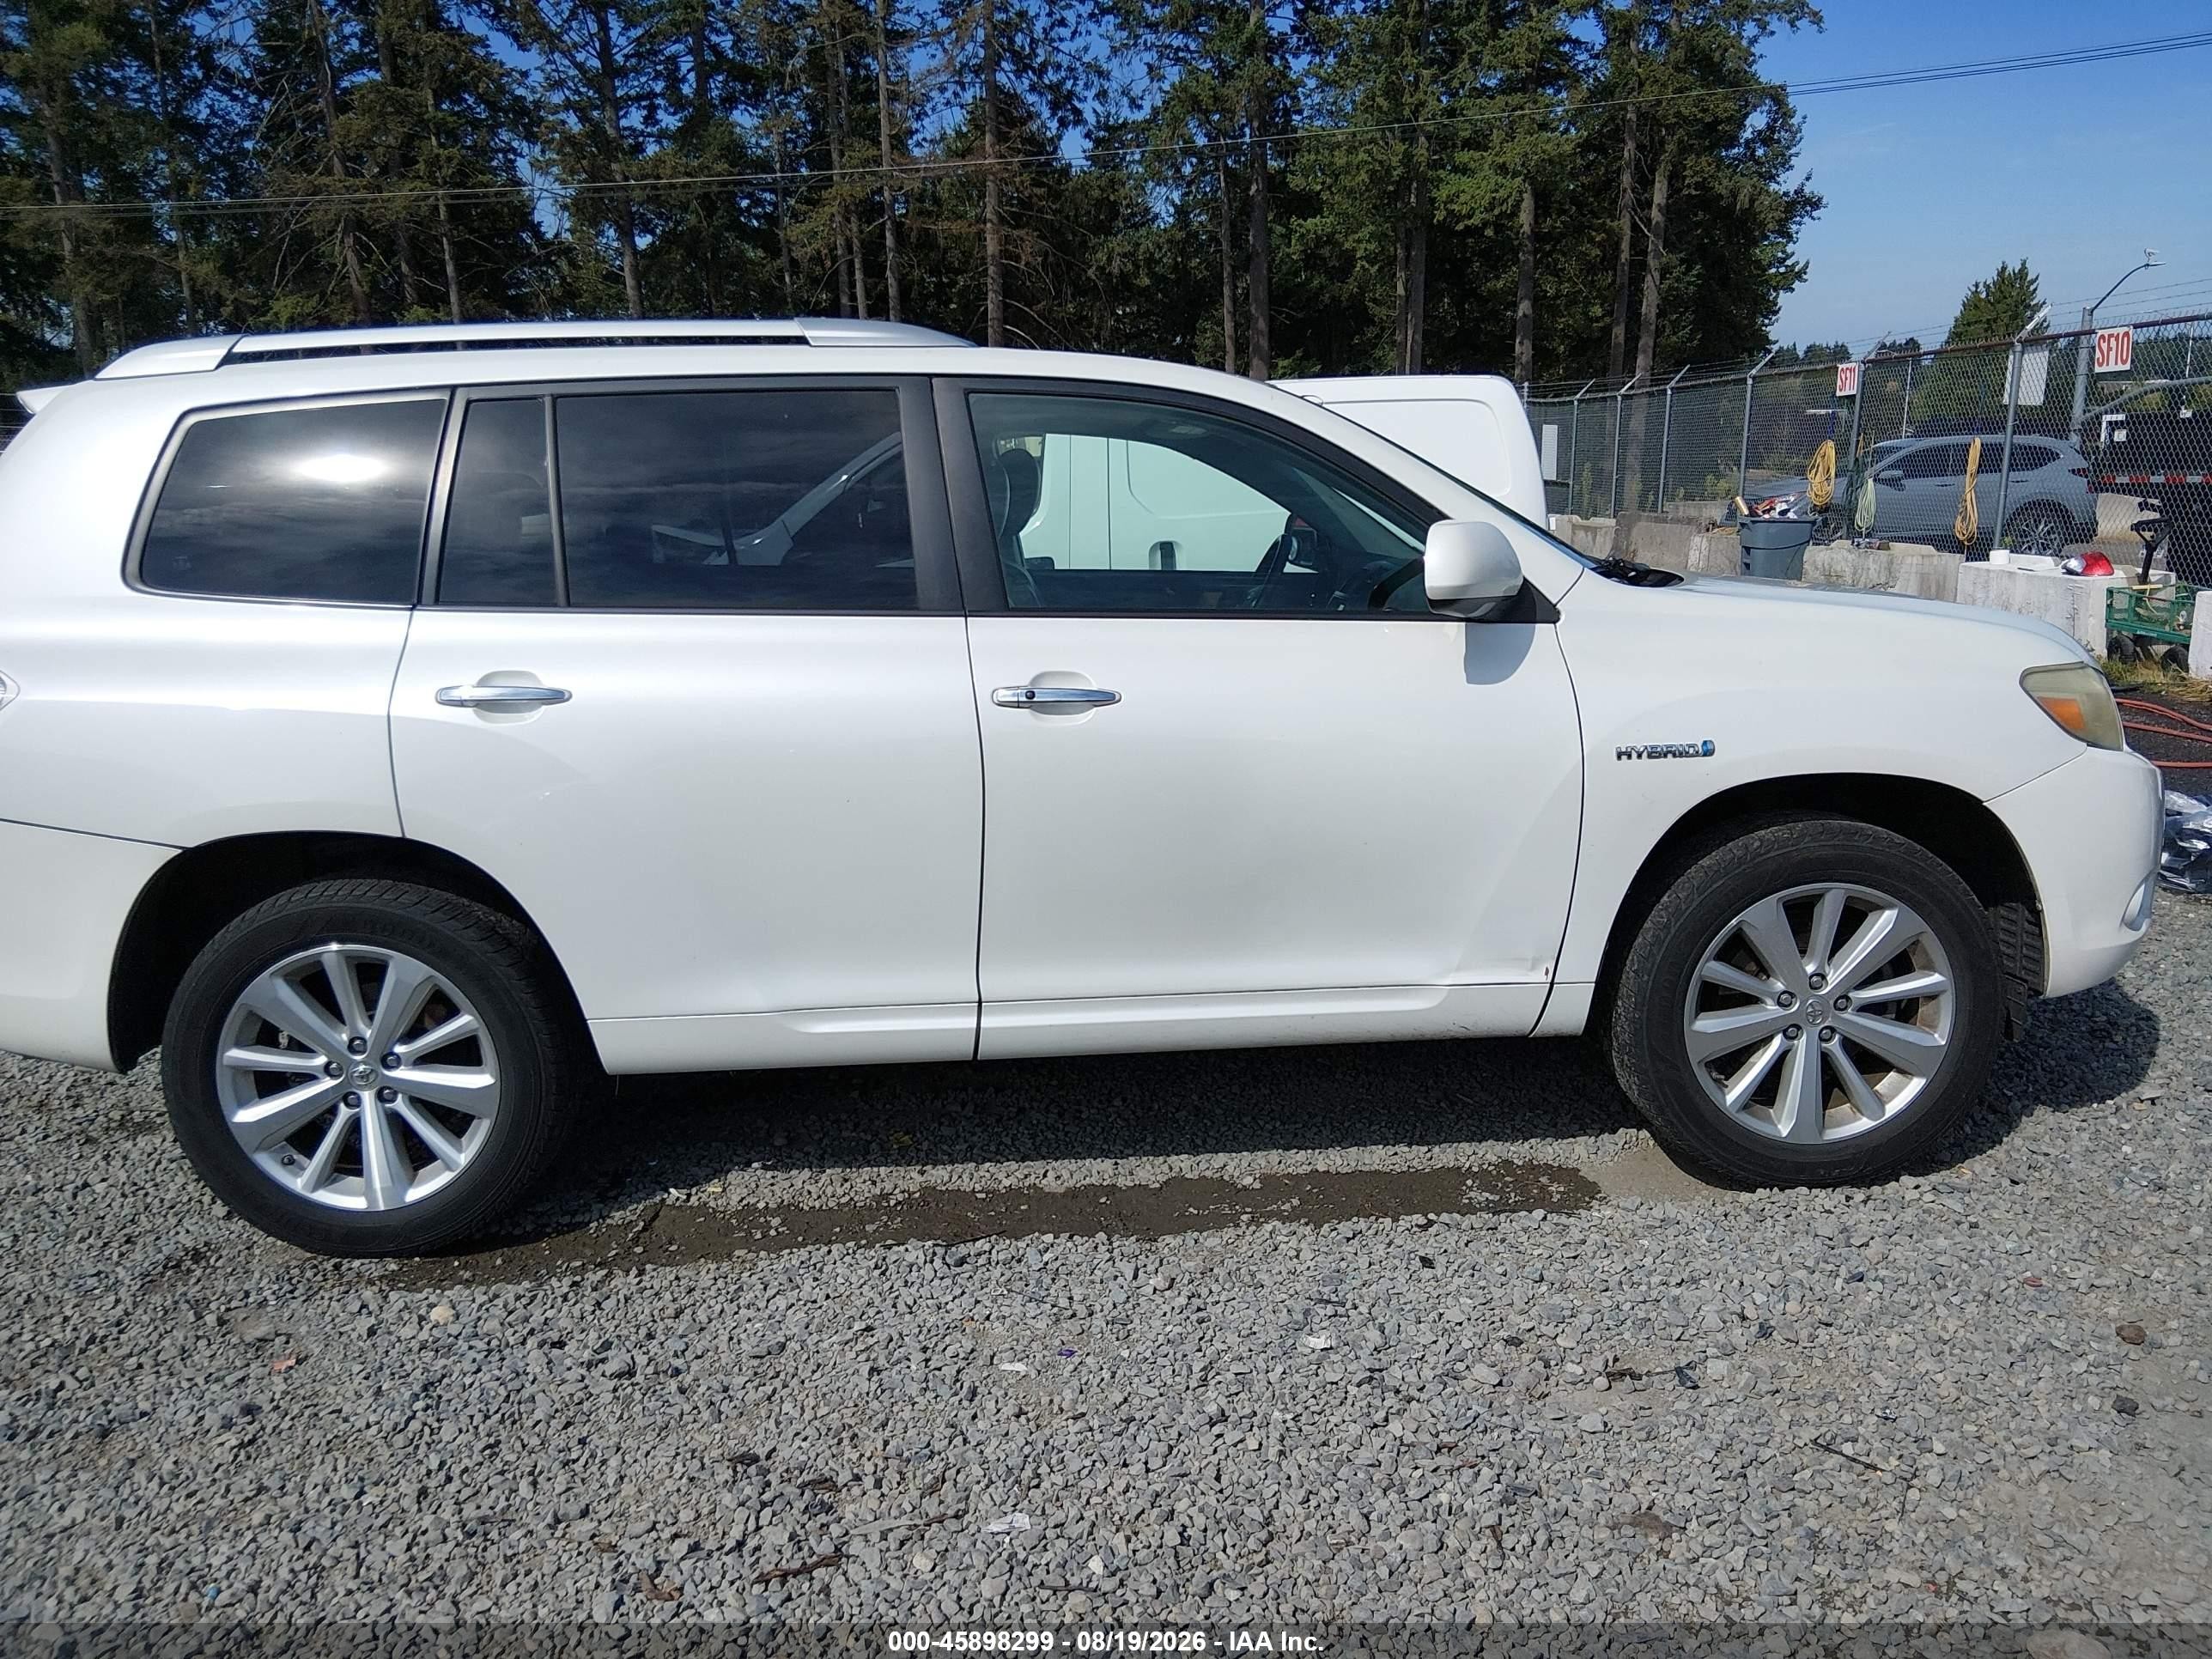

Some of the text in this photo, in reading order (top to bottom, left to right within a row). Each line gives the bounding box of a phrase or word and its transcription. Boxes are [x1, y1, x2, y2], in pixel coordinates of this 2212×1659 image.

[2096, 331, 2130, 368] SF10
[1838, 365, 1856, 392] SF11
[1615, 743, 1699, 761] HYBRID
